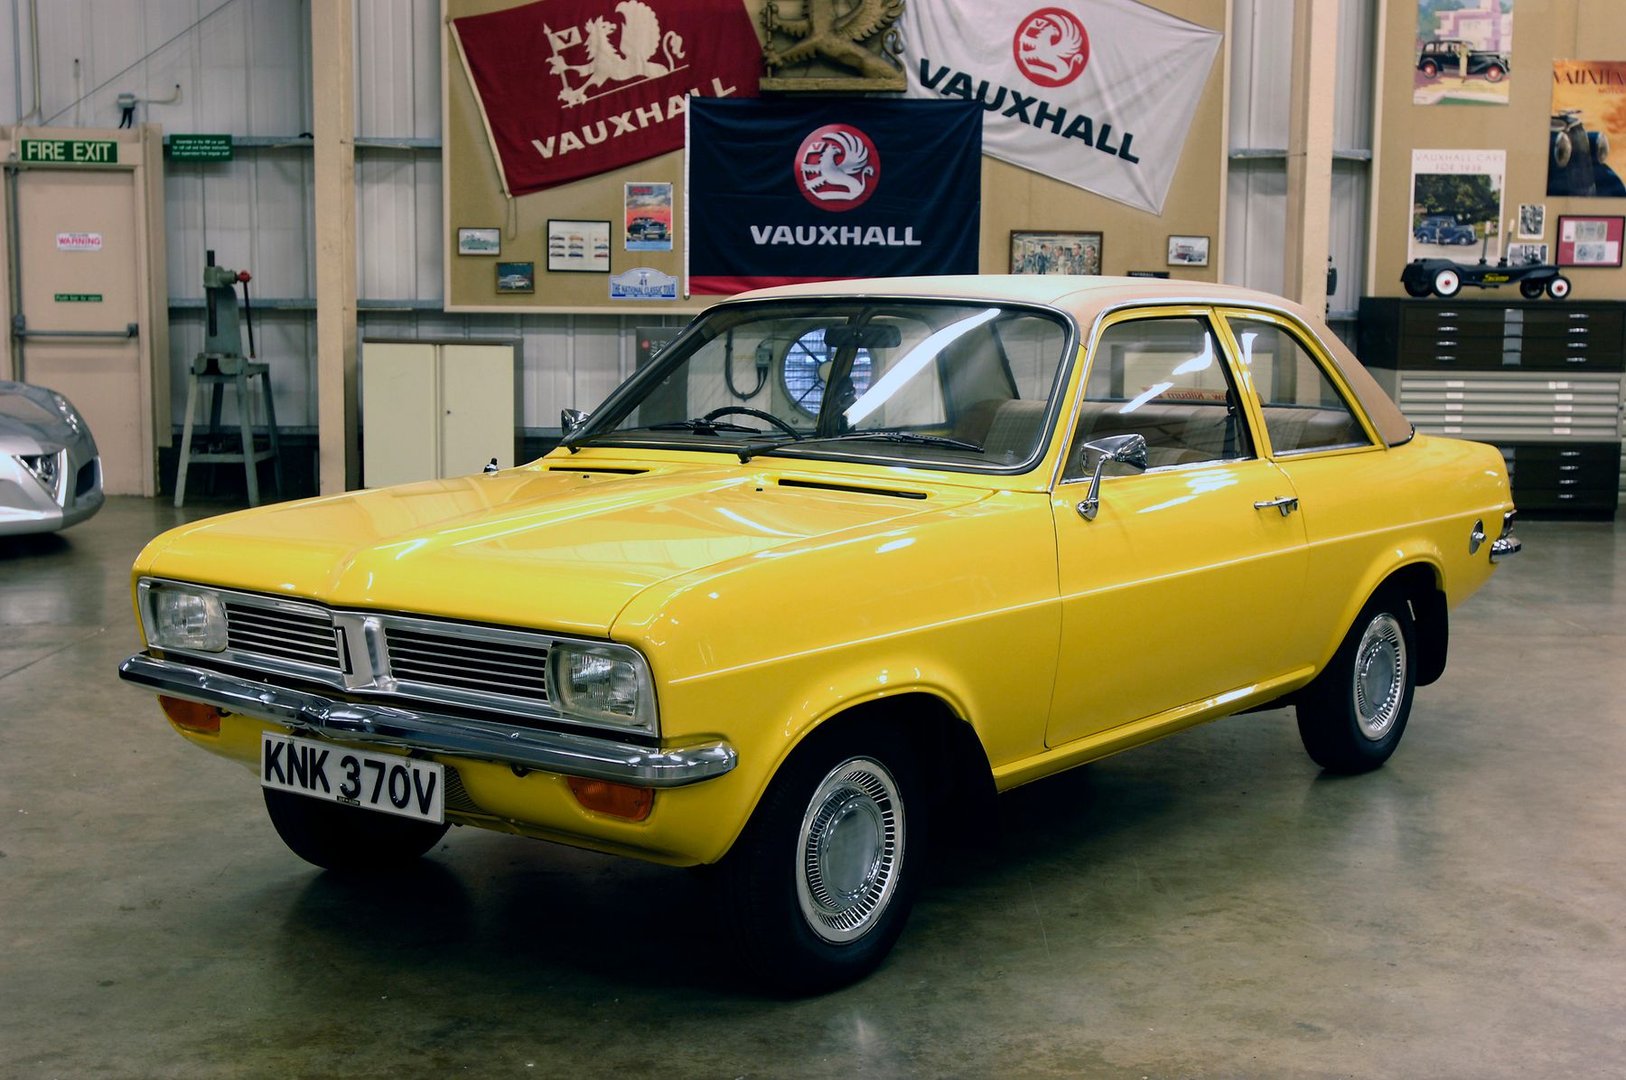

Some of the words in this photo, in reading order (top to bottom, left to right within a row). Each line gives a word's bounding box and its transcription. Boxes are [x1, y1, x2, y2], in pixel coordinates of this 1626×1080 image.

[531, 77, 737, 159] VAUXHAL
[919, 58, 1140, 164] VAUXHALL
[27, 141, 65, 160] FIRE
[73, 142, 111, 161] EXIT
[58, 237, 101, 245] WARNING
[750, 225, 922, 246] VAUXHALL
[621, 285, 643, 295] NATIONAL
[644, 285, 663, 295] CLASSIC
[265, 739, 331, 793] KNK
[339, 755, 437, 815] 370V
